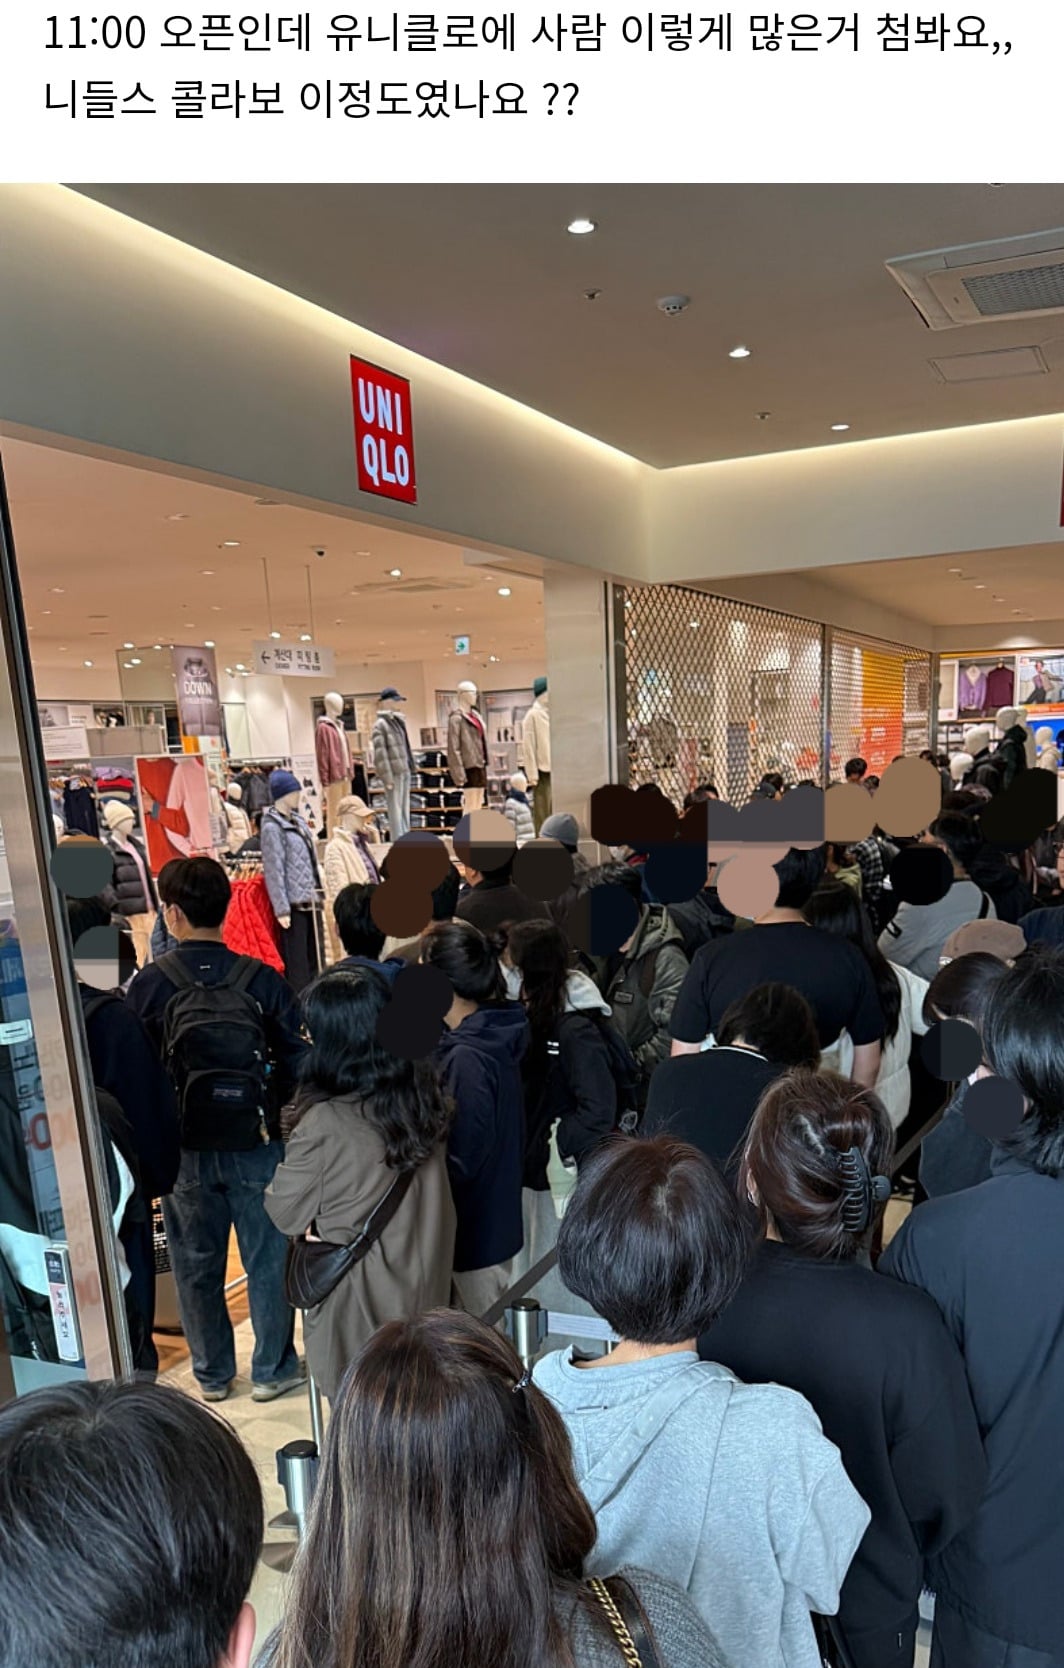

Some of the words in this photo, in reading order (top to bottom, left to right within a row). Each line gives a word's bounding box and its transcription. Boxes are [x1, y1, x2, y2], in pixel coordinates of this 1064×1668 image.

[358, 377, 403, 436] UNI
[362, 433, 410, 487] QLO
[183, 681, 212, 696] DOWN
